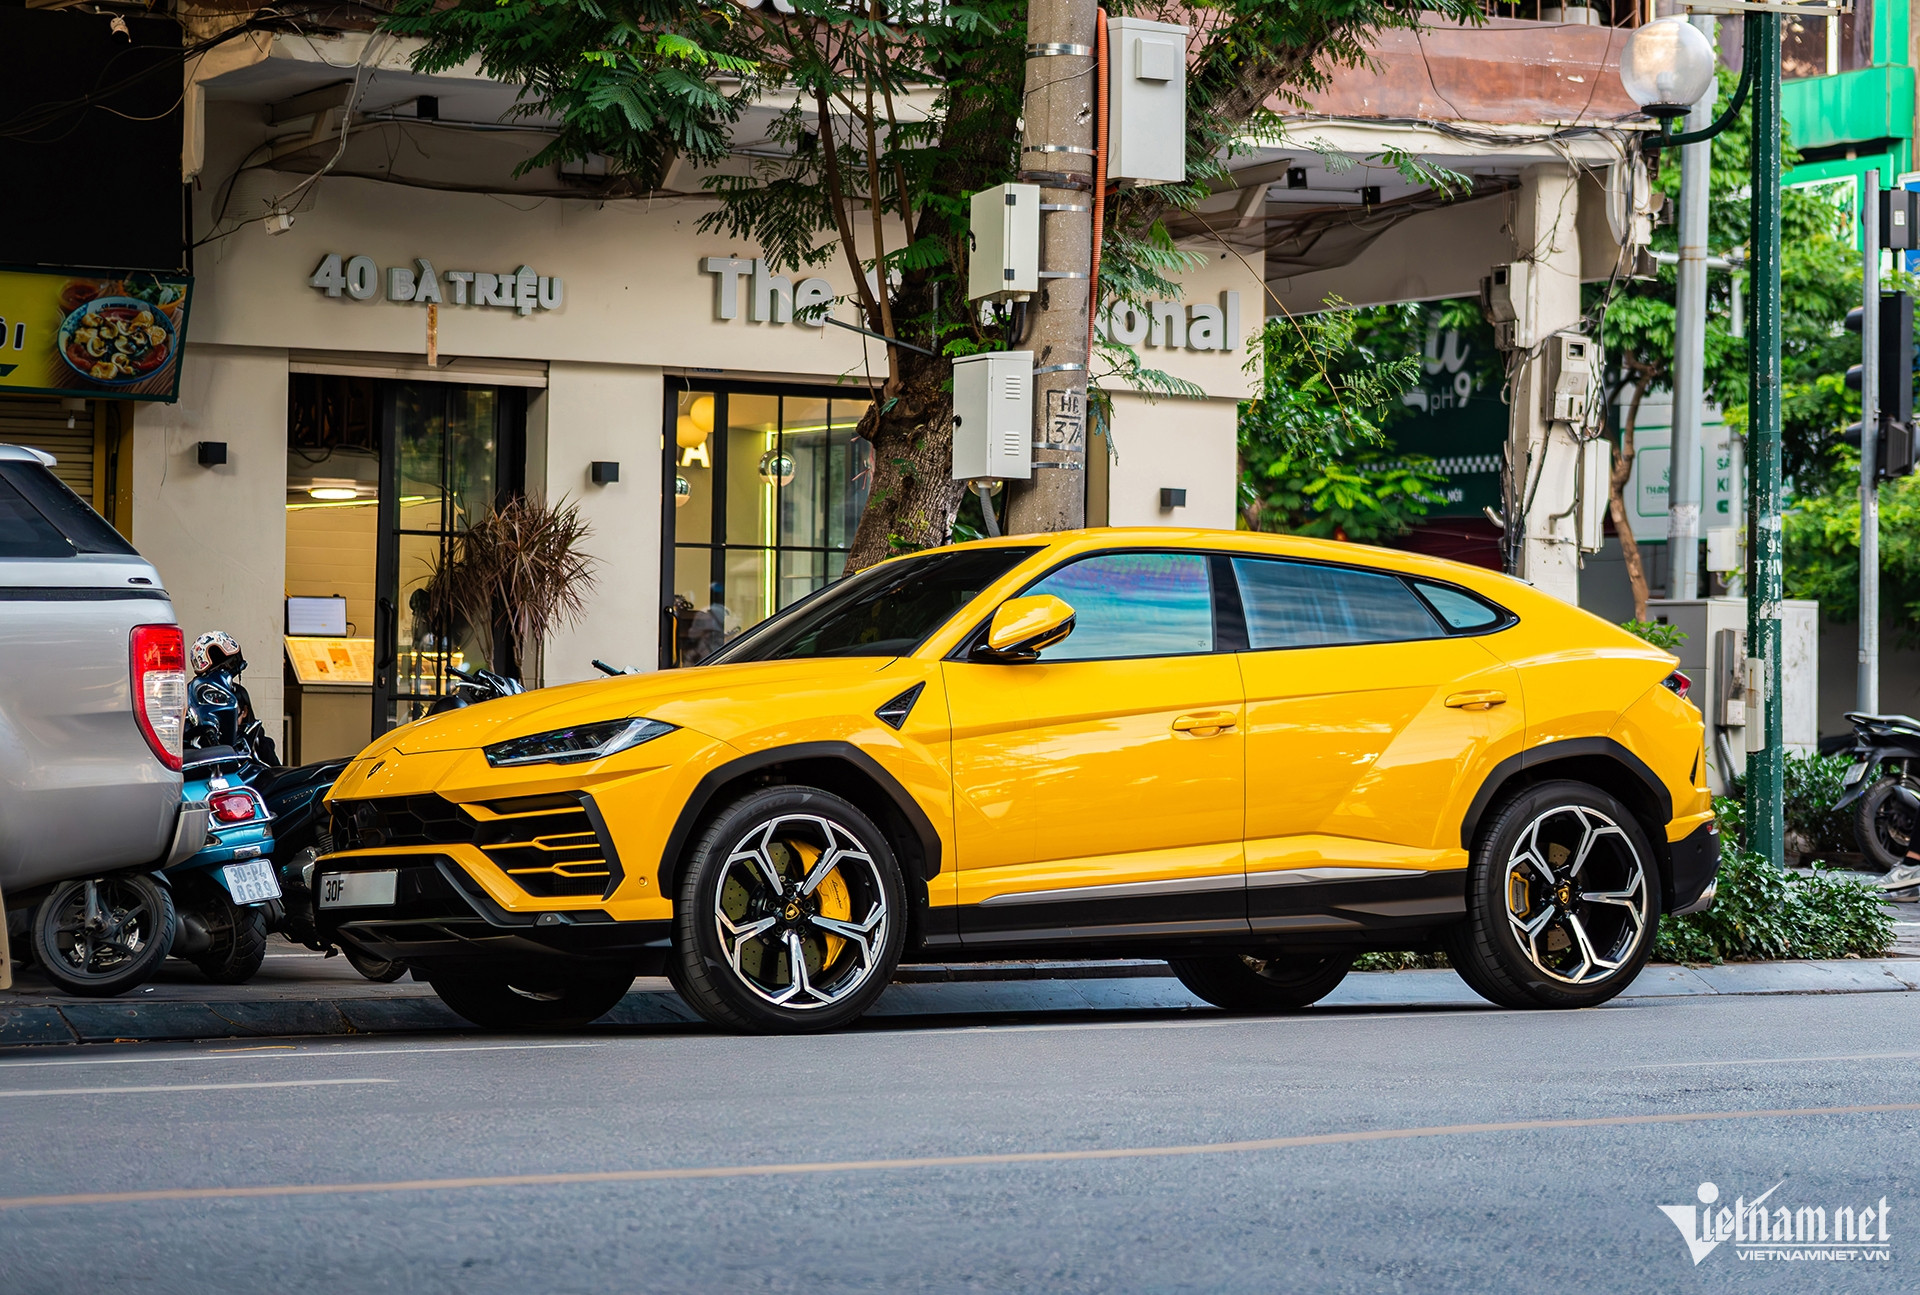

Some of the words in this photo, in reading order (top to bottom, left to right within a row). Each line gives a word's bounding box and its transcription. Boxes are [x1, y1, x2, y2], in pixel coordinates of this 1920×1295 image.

[309, 253, 378, 300] 40
[387, 258, 443, 303] BÀ
[444, 264, 563, 316] TRIỆU
[699, 256, 833, 327] The
[325, 880, 345, 902] 30F
